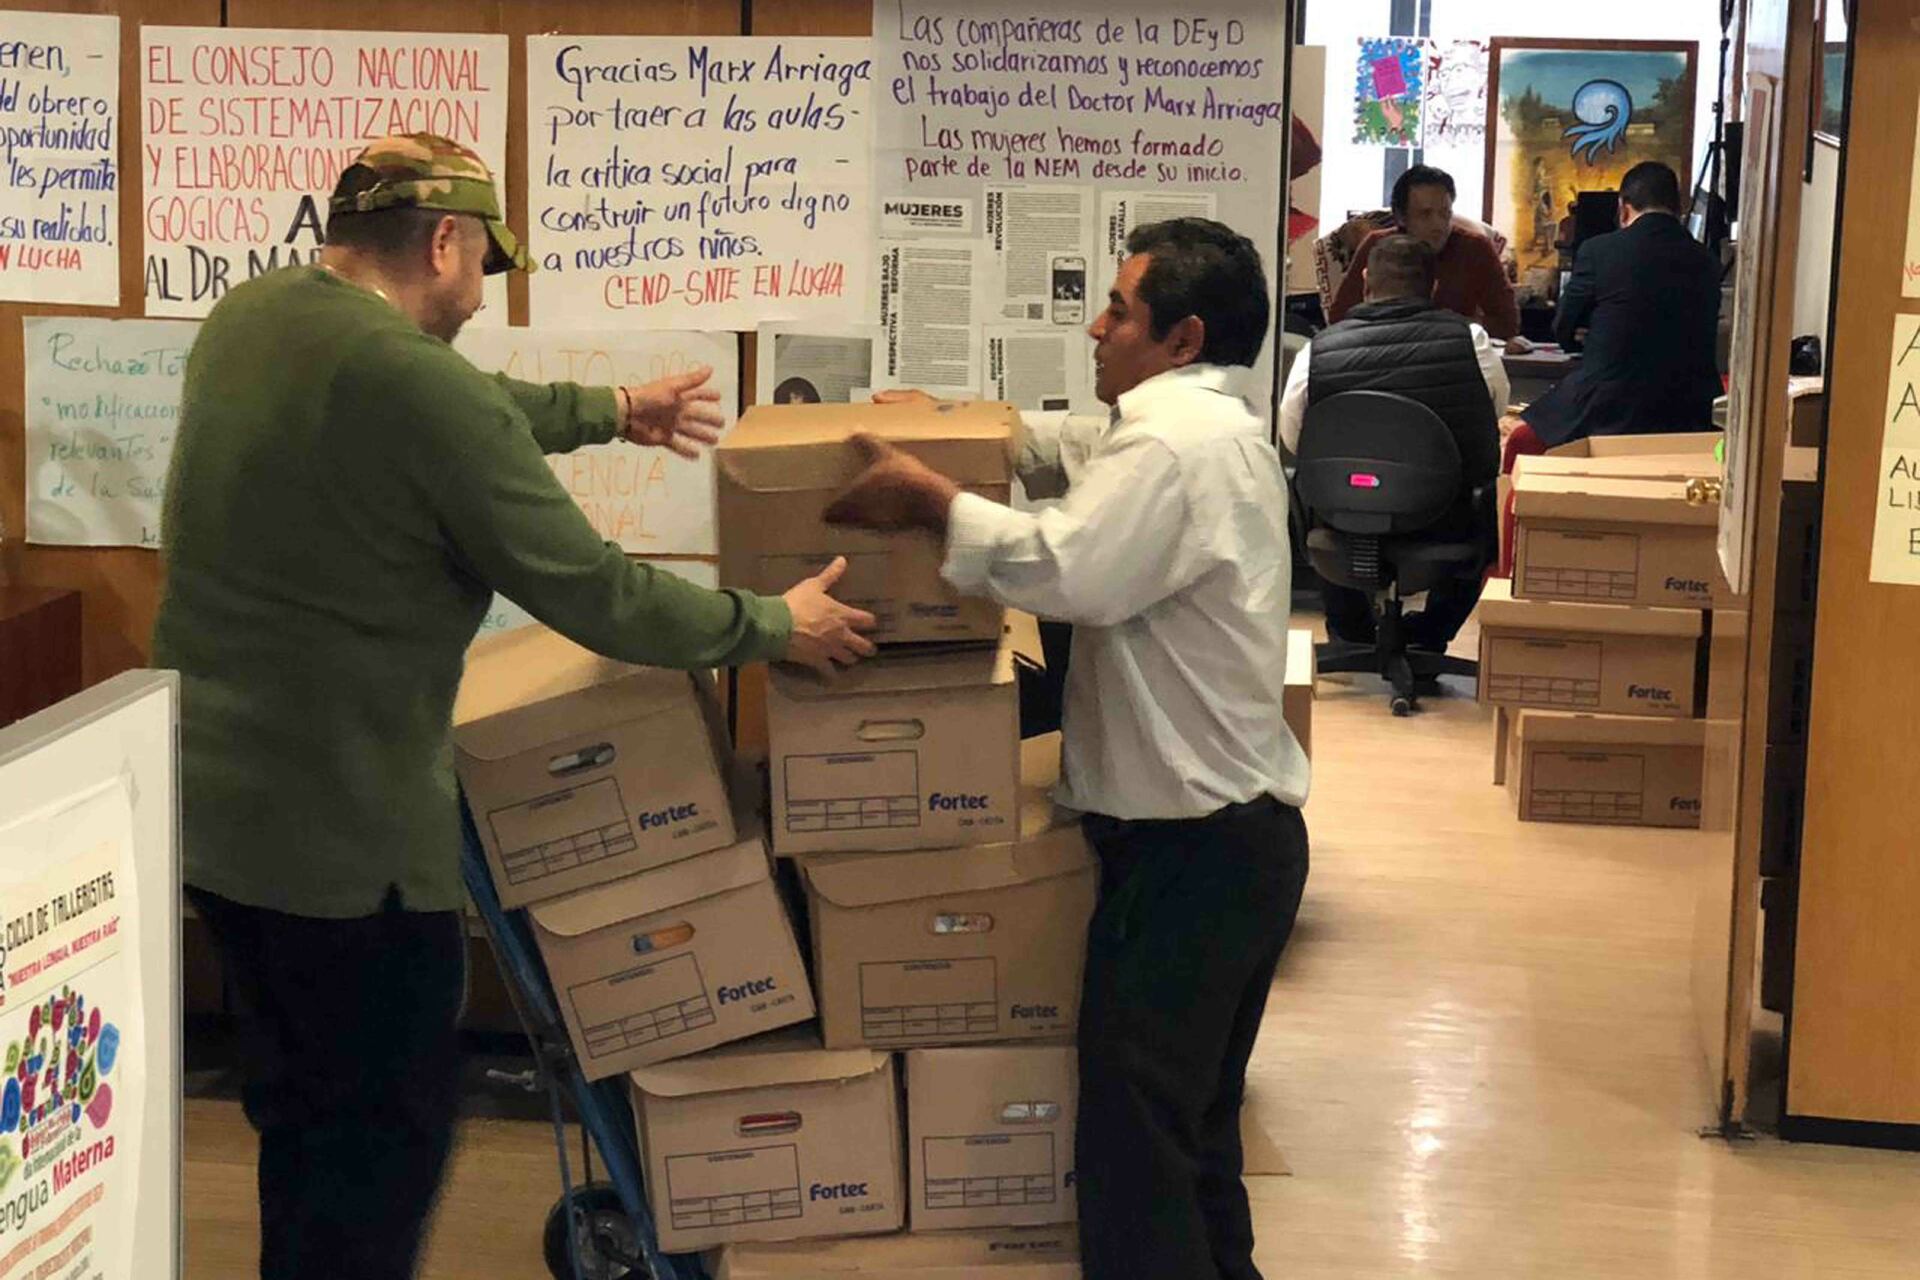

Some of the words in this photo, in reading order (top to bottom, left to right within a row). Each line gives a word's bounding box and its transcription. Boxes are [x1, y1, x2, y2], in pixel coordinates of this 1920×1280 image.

[898, 1, 944, 46] Las
[957, 17, 1082, 51] compañeras
[1096, 17, 1125, 46] de
[1135, 16, 1160, 44] la
[149, 46, 183, 84] EL
[192, 46, 333, 87] CONSEJO
[358, 47, 490, 91] NACIONAL
[556, 45, 677, 101] Gracias
[688, 45, 756, 98] Marx
[764, 45, 871, 96] Arriaga
[902, 51, 942, 72] nos
[952, 47, 1108, 76] solidarizamos
[1118, 56, 1129, 86] y
[1136, 57, 1264, 79] reconocemos
[28, 85, 108, 115] obrero
[149, 98, 188, 135] DE
[200, 96, 481, 142] SISTEMATIZACION
[545, 105, 604, 145] por
[606, 98, 682, 131] traer
[684, 106, 706, 130] a
[723, 93, 757, 132] las
[892, 75, 915, 105] el
[926, 75, 1010, 118] trabajo
[1018, 81, 1057, 109] del
[1068, 84, 1135, 112] Doctor
[1143, 85, 1196, 117] Marx
[1202, 86, 1282, 126] Arriaga
[921, 114, 963, 151] Las
[971, 126, 1047, 157] mujeres
[1057, 126, 1122, 155] hemos
[1133, 129, 1224, 157] formado
[10, 157, 36, 188] les
[146, 144, 162, 187] Y
[547, 154, 571, 188] la
[662, 145, 733, 186] social
[744, 157, 797, 197] para
[905, 155, 959, 181] parte
[966, 155, 991, 178] de
[1004, 154, 1026, 178] la
[1034, 158, 1081, 179] NEM
[1092, 159, 1147, 179] desde
[147, 195, 270, 243] GOGICAS
[541, 197, 655, 232] construir
[664, 202, 691, 222] un
[698, 184, 770, 228] futuro
[781, 181, 850, 229] digno
[884, 202, 963, 218] MUJERES
[17, 244, 82, 271] LUCHA
[543, 252, 562, 272] a
[576, 226, 684, 269] nuestros
[699, 228, 763, 259] niños.
[882, 254, 890, 281] BAJO
[891, 247, 899, 294] REFORMA
[145, 254, 182, 301] AL
[604, 266, 739, 309] CEND-SNTE
[753, 264, 781, 297] EN
[787, 259, 846, 298] LUCHA
[881, 283, 889, 326] MUJERES
[888, 312, 898, 377] PERSPECTIVA
[549, 453, 669, 499] ENCIA
[1663, 577, 1709, 594] Fortec
[1627, 685, 1673, 701] Fortec
[638, 802, 699, 831] Fortec
[928, 792, 988, 811] Fortec
[7, 911, 34, 951] CICLO
[37, 903, 49, 935] DE
[717, 976, 776, 1006] Fortec
[1010, 1004, 1059, 1020] Fortec
[52, 1135, 115, 1195] Materna
[809, 1181, 868, 1201] Fortec
